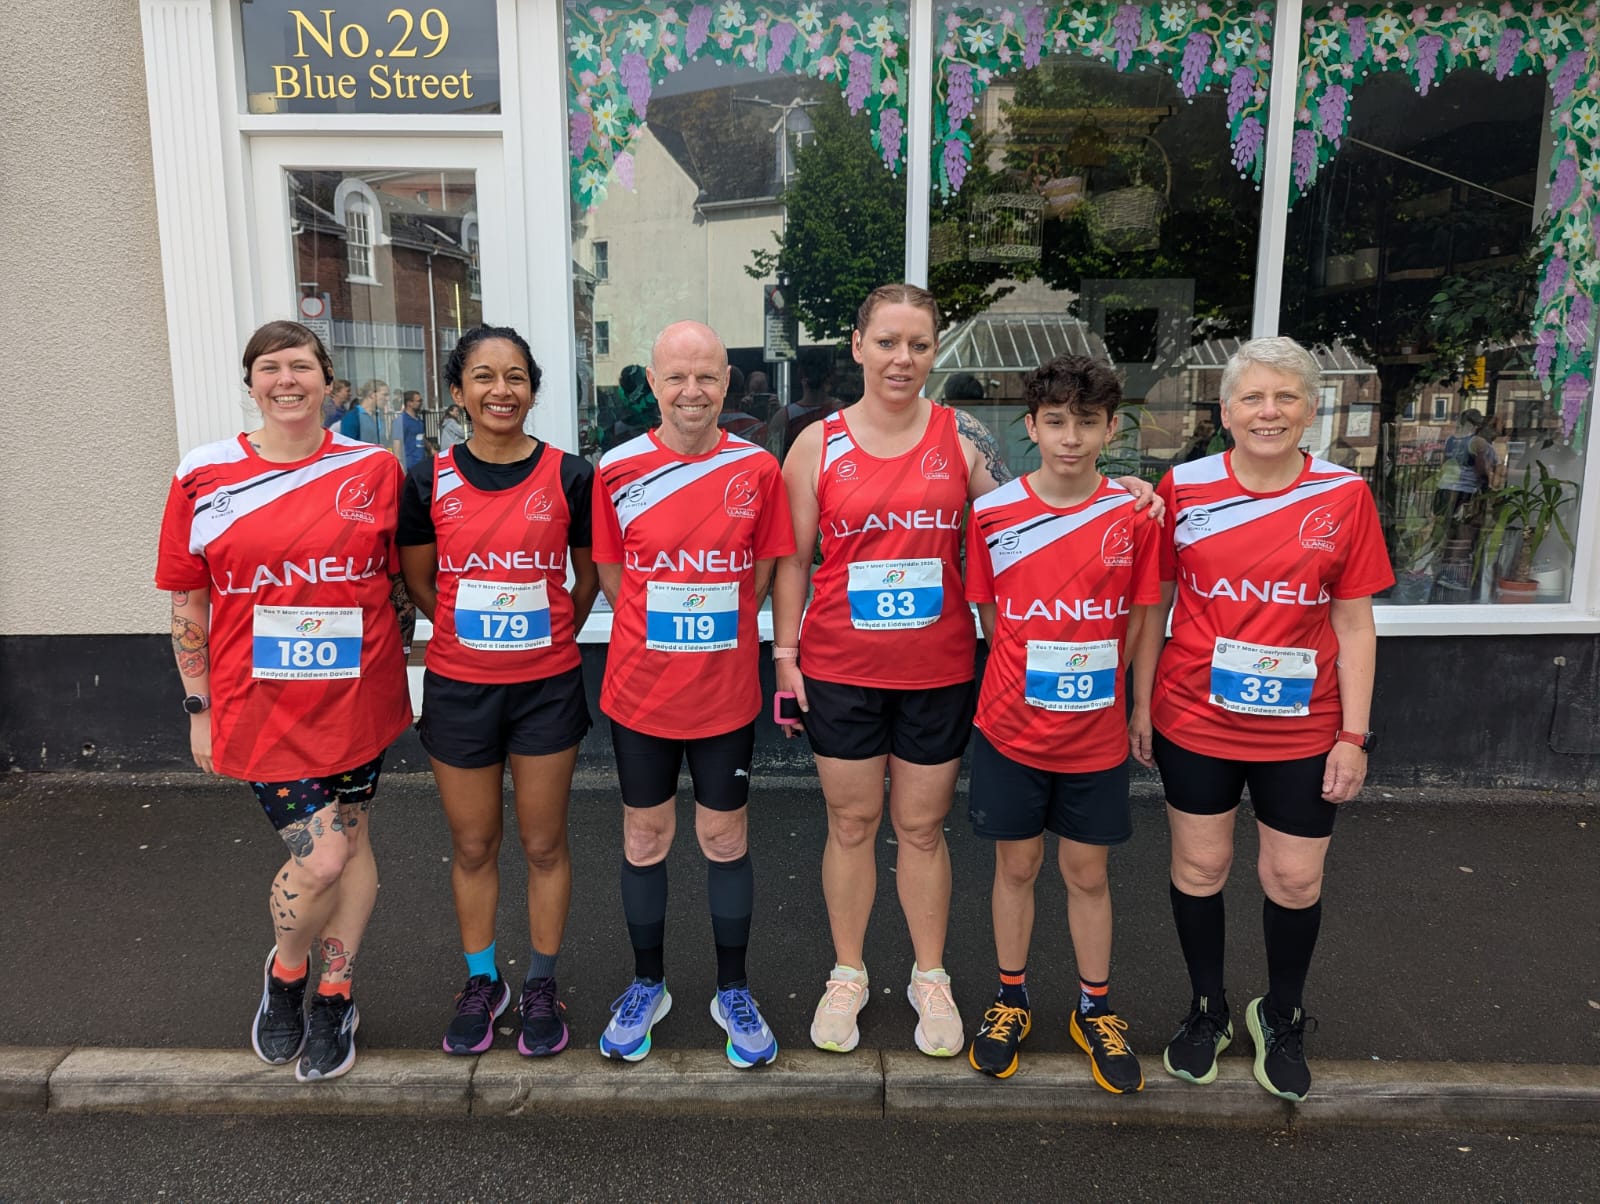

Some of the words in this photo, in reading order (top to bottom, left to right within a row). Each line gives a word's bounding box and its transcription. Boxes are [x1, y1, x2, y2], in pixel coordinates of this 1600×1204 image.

[287, 8, 450, 59] No.29
[271, 63, 357, 99] Blue
[368, 63, 474, 100] Street
[877, 591, 915, 617] 83
[480, 614, 528, 639] 179
[673, 616, 715, 640] 119
[278, 640, 338, 667] 180
[1056, 675, 1094, 699] 59
[1240, 677, 1282, 704] 33
